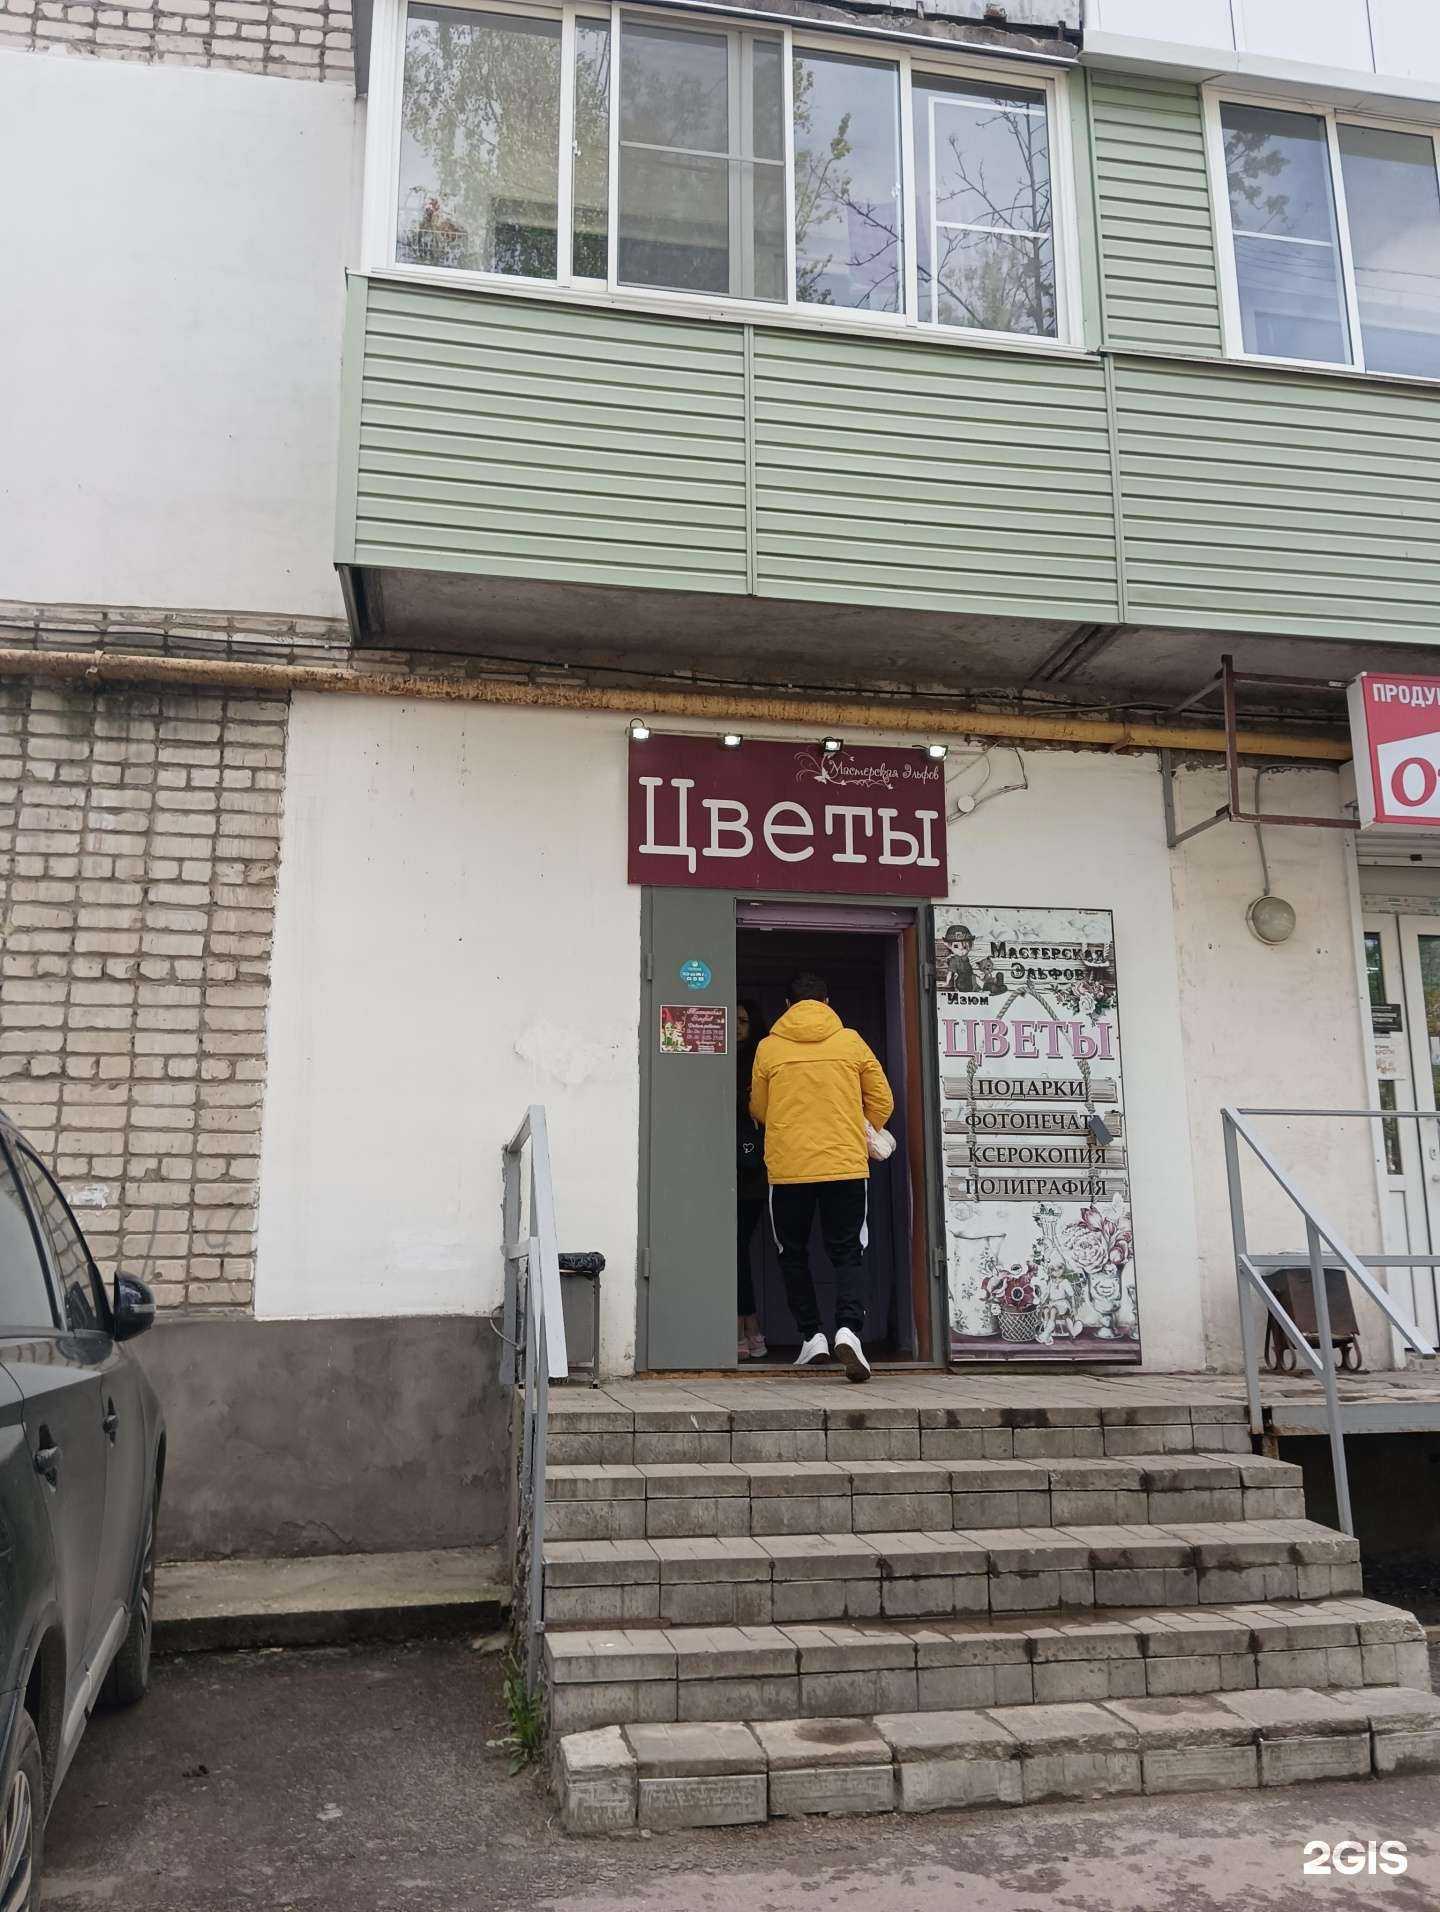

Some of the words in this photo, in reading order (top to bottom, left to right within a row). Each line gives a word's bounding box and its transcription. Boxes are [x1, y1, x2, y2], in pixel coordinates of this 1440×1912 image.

[829, 760, 899, 783] Мастерская
[902, 763, 940, 784] Эльфов
[1391, 757, 1440, 807] О
[638, 776, 941, 874] Цветы
[942, 1018, 1115, 1066] ЦВЕТЫ
[978, 1079, 1085, 1099] ПОДАРКИ
[965, 1112, 1095, 1130] ФОТОПЕЧАТ
[969, 1147, 1106, 1164] КСЕРОКОПИЯ
[965, 1178, 1107, 1196] ПОЛИГРАФИЯ
